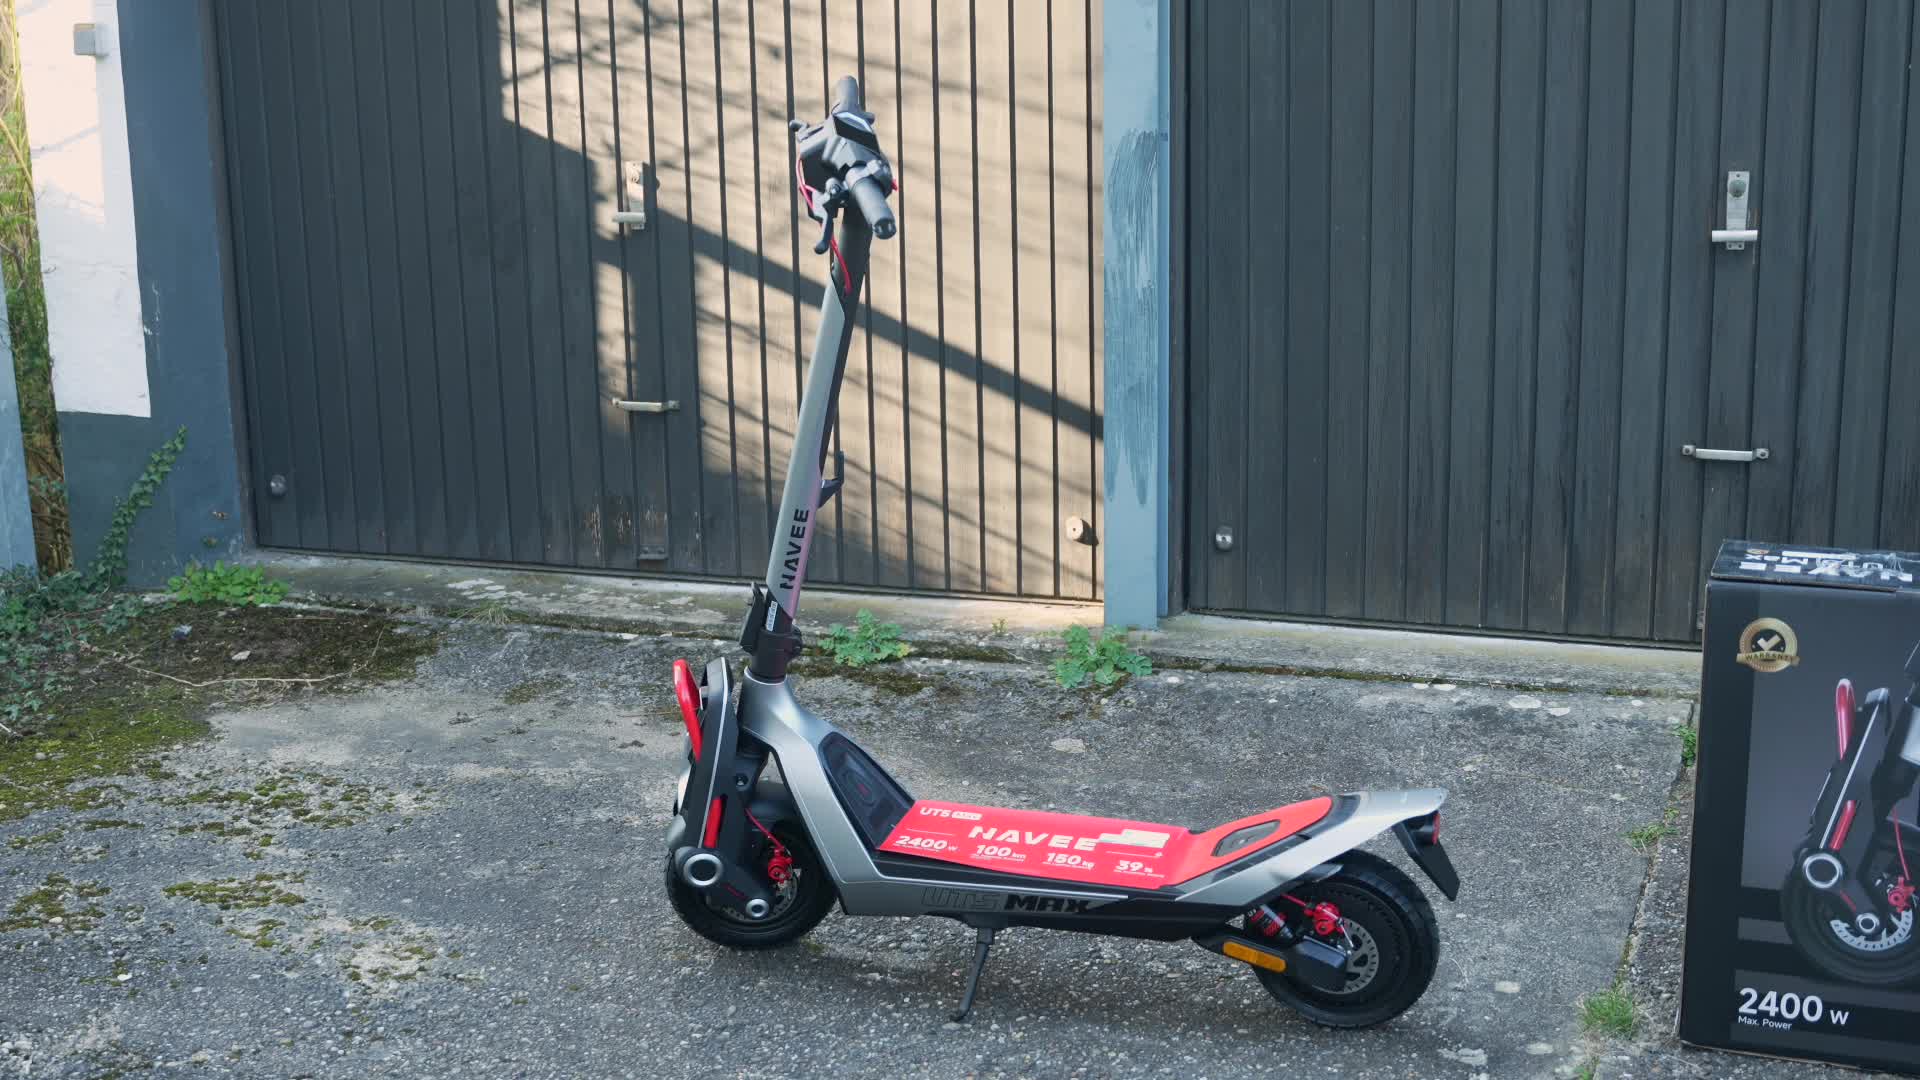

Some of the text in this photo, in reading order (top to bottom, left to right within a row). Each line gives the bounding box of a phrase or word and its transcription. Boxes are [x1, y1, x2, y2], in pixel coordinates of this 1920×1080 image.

[779, 508, 809, 590] NAVEE
[1744, 652, 1793, 662] WARRANTY
[895, 835, 948, 850] 2400
[968, 826, 1098, 851] NAVEE
[976, 845, 1012, 857] 100
[1046, 853, 1082, 865] 150
[1115, 860, 1144, 872] 39
[1004, 894, 1089, 912] MAX
[1738, 987, 1849, 1025] 2400 W
[1738, 1015, 1792, 1031] Max. Power
